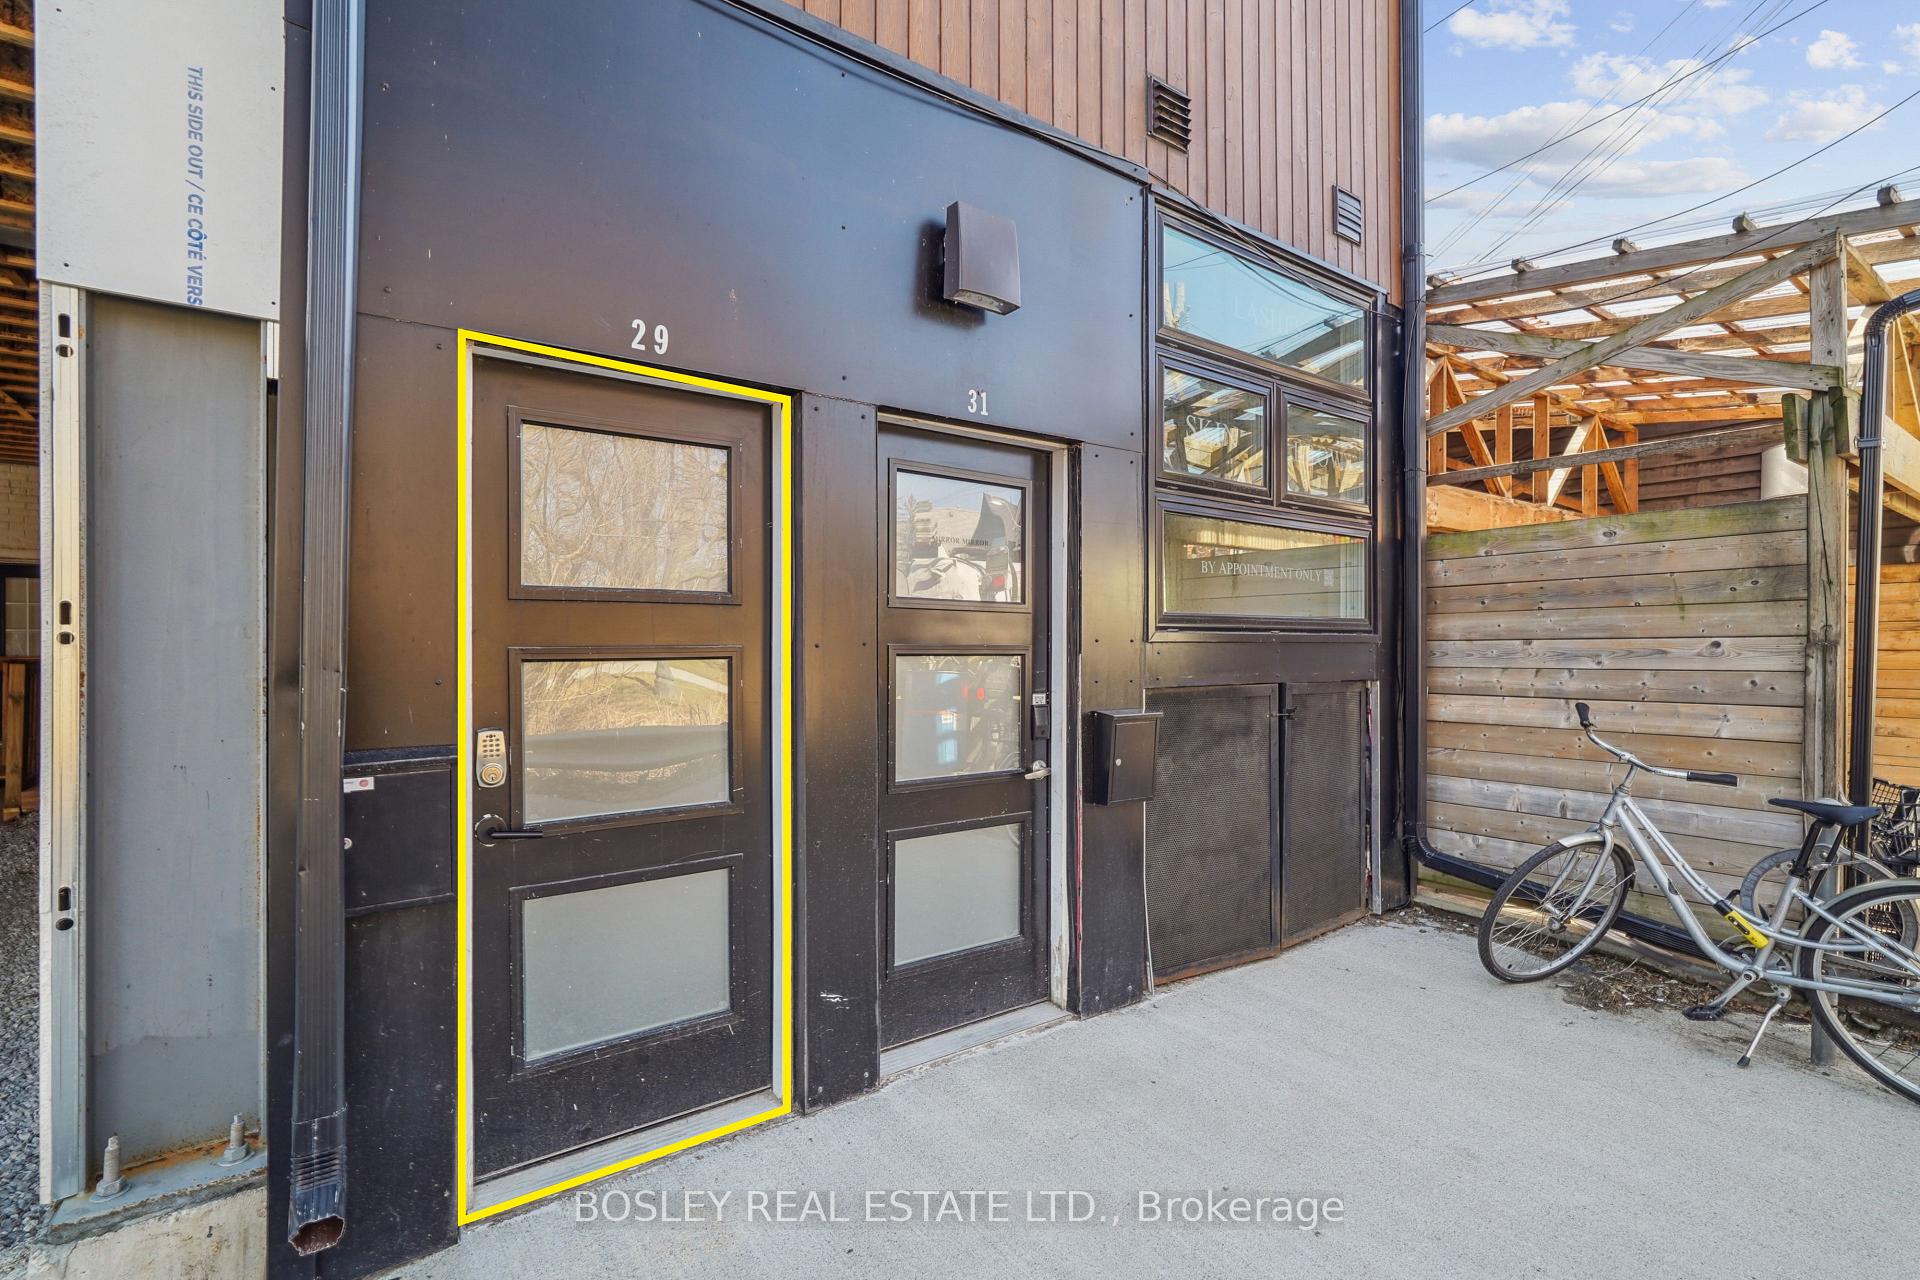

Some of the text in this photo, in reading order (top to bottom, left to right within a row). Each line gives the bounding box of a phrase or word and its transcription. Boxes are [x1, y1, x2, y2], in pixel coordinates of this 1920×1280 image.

[187, 67, 203, 102] THIS
[187, 103, 203, 142] SIDE
[187, 144, 203, 179] OUT
[187, 194, 203, 215] CE
[187, 218, 207, 261] CÔTÉ
[187, 265, 203, 306] VERS
[631, 318, 669, 355] 29
[967, 389, 989, 416] 31
[1201, 560, 1323, 582] BY APPOINTMENT ONLY
